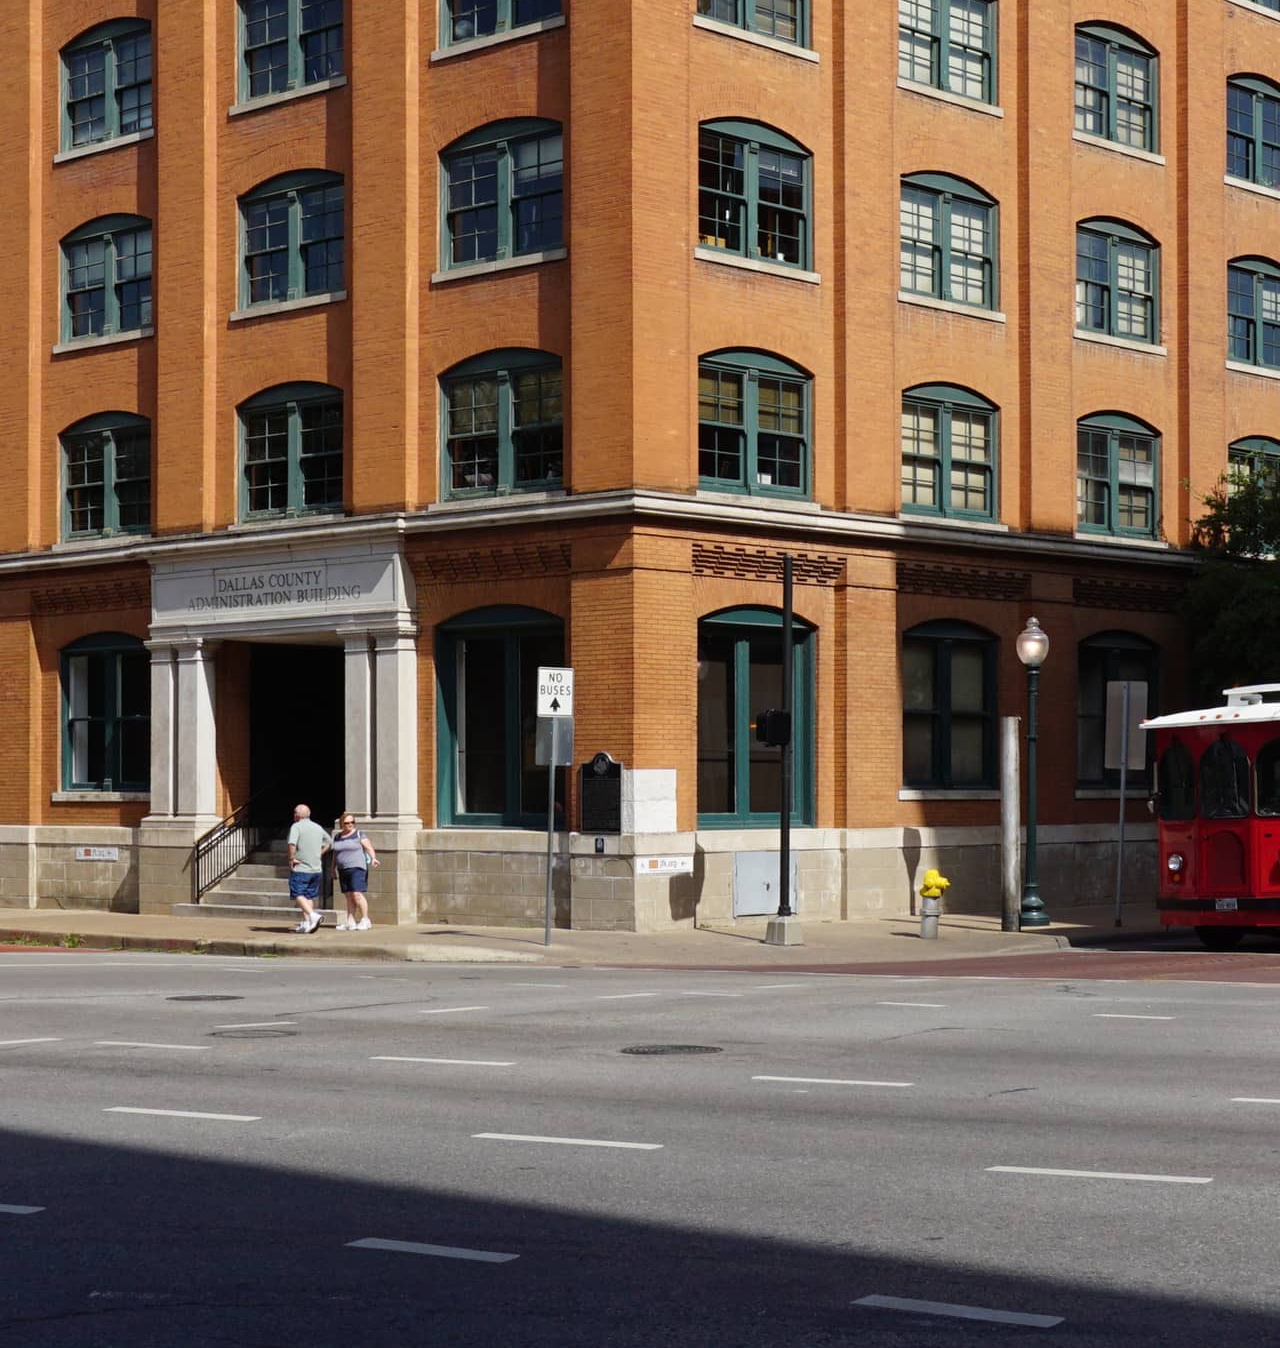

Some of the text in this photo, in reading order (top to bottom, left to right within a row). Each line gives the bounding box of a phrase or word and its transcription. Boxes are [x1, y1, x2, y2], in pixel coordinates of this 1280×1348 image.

[218, 570, 322, 593] DALLAS COUNTY
[188, 585, 361, 612] ADMINISTRATION BUILDING
[549, 672, 563, 683] NO
[540, 685, 571, 696] BUSES
